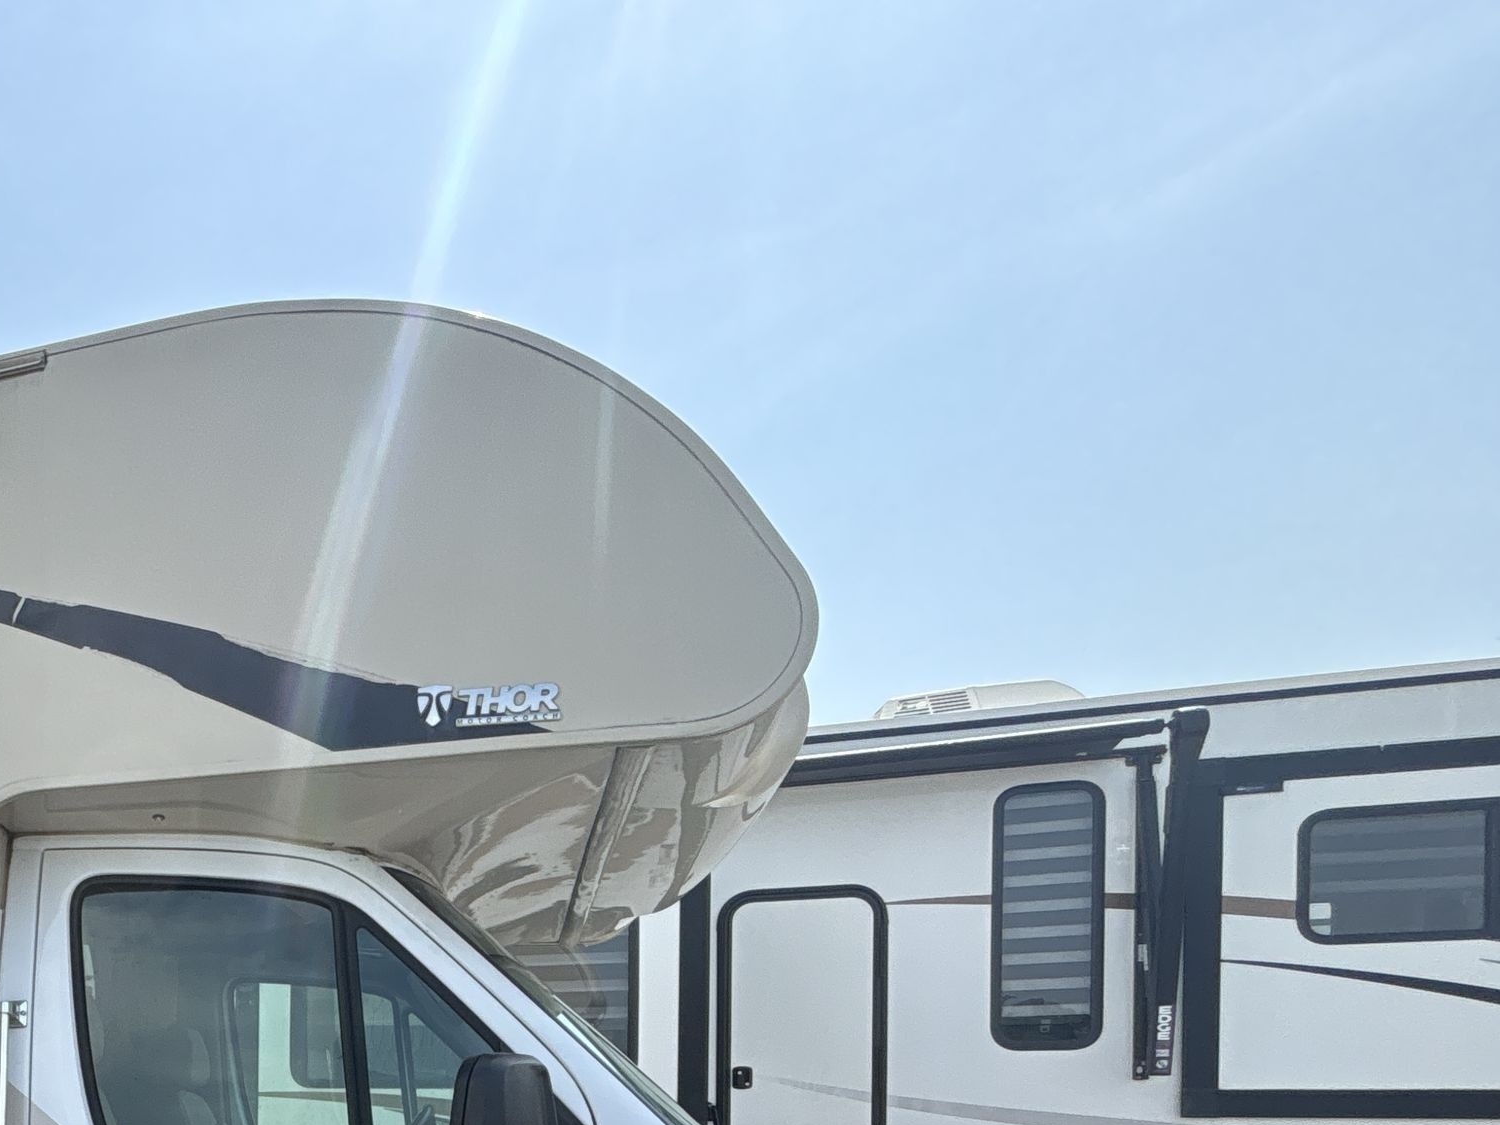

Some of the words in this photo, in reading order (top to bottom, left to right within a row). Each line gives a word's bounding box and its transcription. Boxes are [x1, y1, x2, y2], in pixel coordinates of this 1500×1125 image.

[458, 683, 560, 716] THOR
[457, 716, 502, 725] MOTOR
[513, 712, 558, 722] COACH
